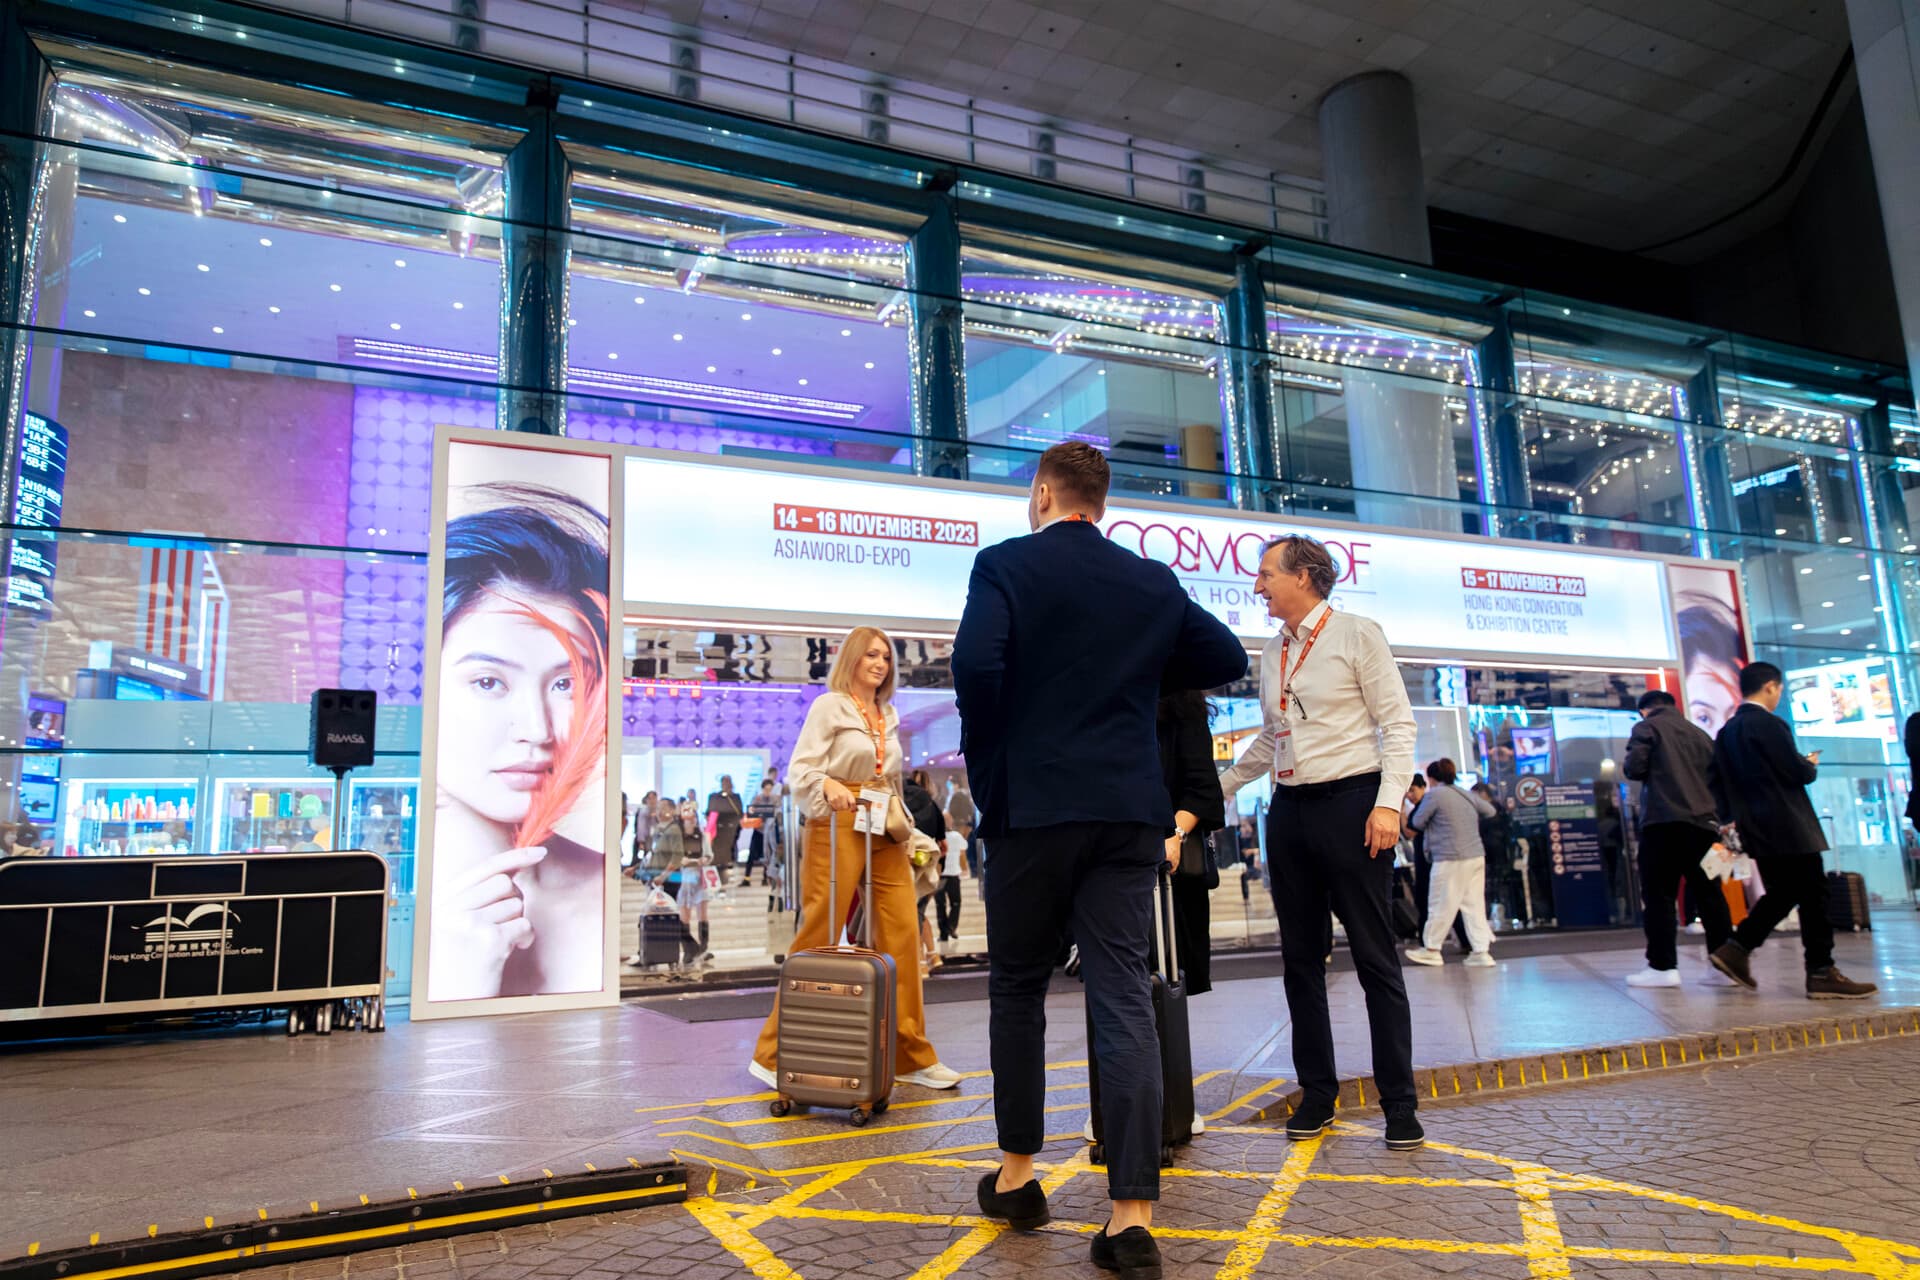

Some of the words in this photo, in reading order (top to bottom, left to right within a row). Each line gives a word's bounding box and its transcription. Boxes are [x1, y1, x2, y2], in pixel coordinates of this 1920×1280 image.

[776, 507, 798, 528] 14
[816, 511, 836, 532] 16
[839, 513, 932, 540] NOVEMBER
[934, 522, 976, 544] 2023
[774, 538, 911, 567] ASIAWORLD-EXPO
[1106, 520, 1371, 585] COSMOOF
[1463, 570, 1476, 587] 15
[1486, 571, 1498, 589] 17
[1499, 572, 1557, 593] NOVEMBER
[1557, 577, 1584, 595] 2023
[1210, 587, 1267, 607] HON
[1464, 594, 1492, 611] HONG
[1494, 596, 1521, 612] KONG
[1523, 598, 1583, 616] CONVENTION
[1466, 614, 1474, 630] &
[1476, 615, 1531, 632] EXHIBITION
[1533, 618, 1568, 635] CENTRE
[327, 733, 365, 743] RAMSA
[110, 954, 129, 962] Hong
[130, 953, 150, 961] Kong
[241, 947, 264, 955] Centre
